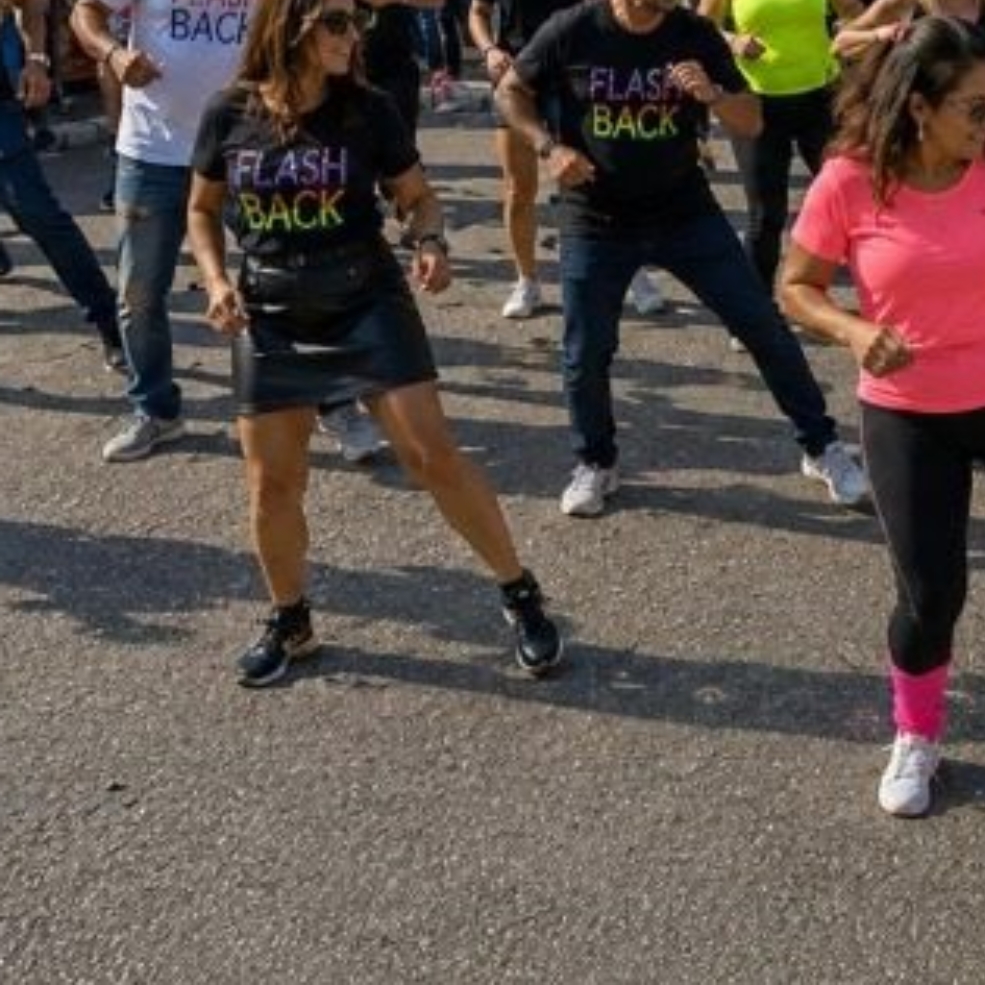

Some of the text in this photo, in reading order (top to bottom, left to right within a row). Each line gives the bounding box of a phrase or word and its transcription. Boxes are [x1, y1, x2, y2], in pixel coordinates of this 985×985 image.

[592, 104, 678, 139] BACK
[233, 147, 347, 187] FLASH
[241, 189, 345, 232] BACK
